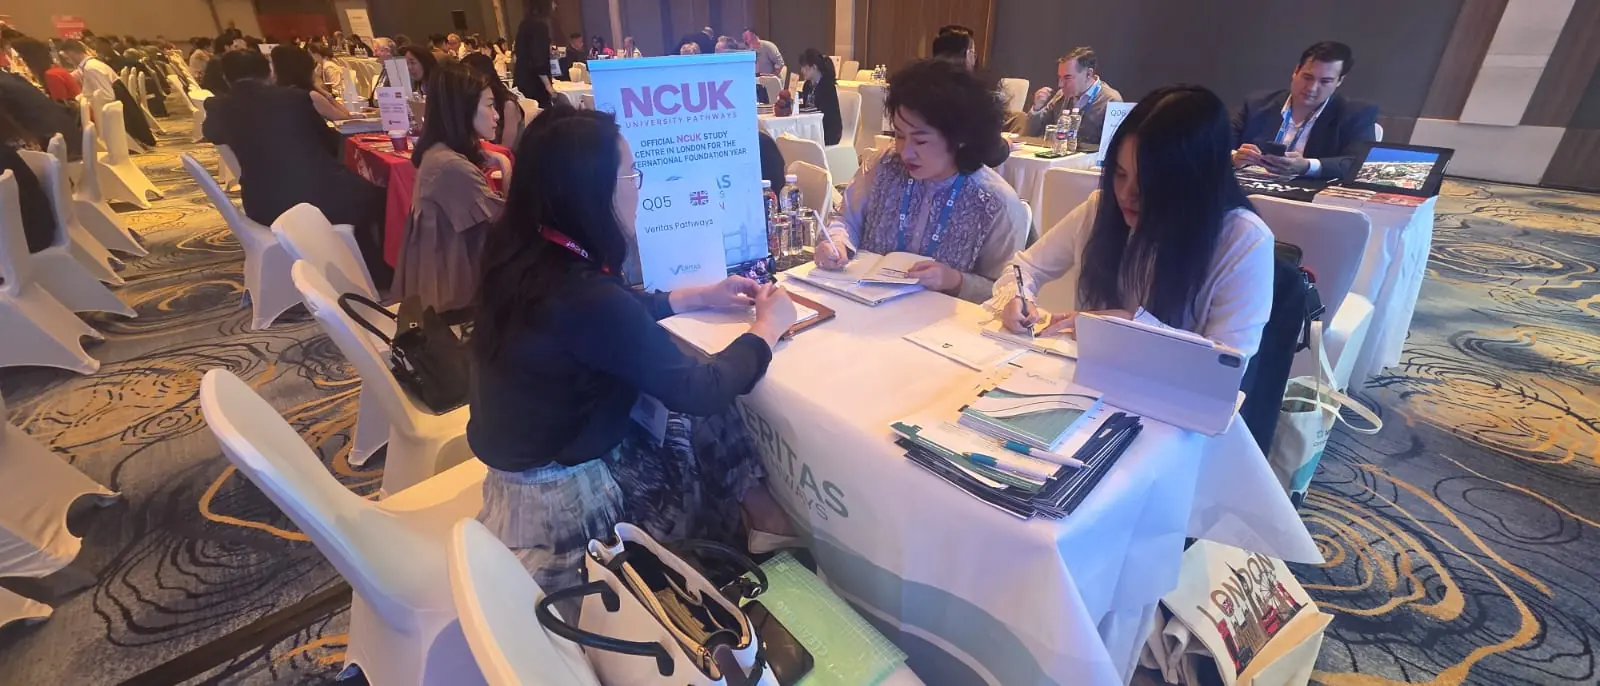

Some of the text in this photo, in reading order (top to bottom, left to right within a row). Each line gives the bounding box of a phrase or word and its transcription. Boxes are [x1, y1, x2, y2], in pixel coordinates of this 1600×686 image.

[620, 80, 736, 118] NCUK
[626, 112, 737, 129] UNIVERSITY PATHWAYS
[641, 131, 728, 147] OFFICIAL NCUK STUDY
[635, 139, 736, 159] CENTRE IN LONDON FOR THE
[684, 150, 729, 162] FOUNDATION
[729, 147, 747, 157] YEAR
[642, 196, 672, 211] Q05
[645, 218, 714, 234] Veritas Pathways
[741, 401, 849, 518] ERITAS
[1196, 552, 1276, 627] LONDON
